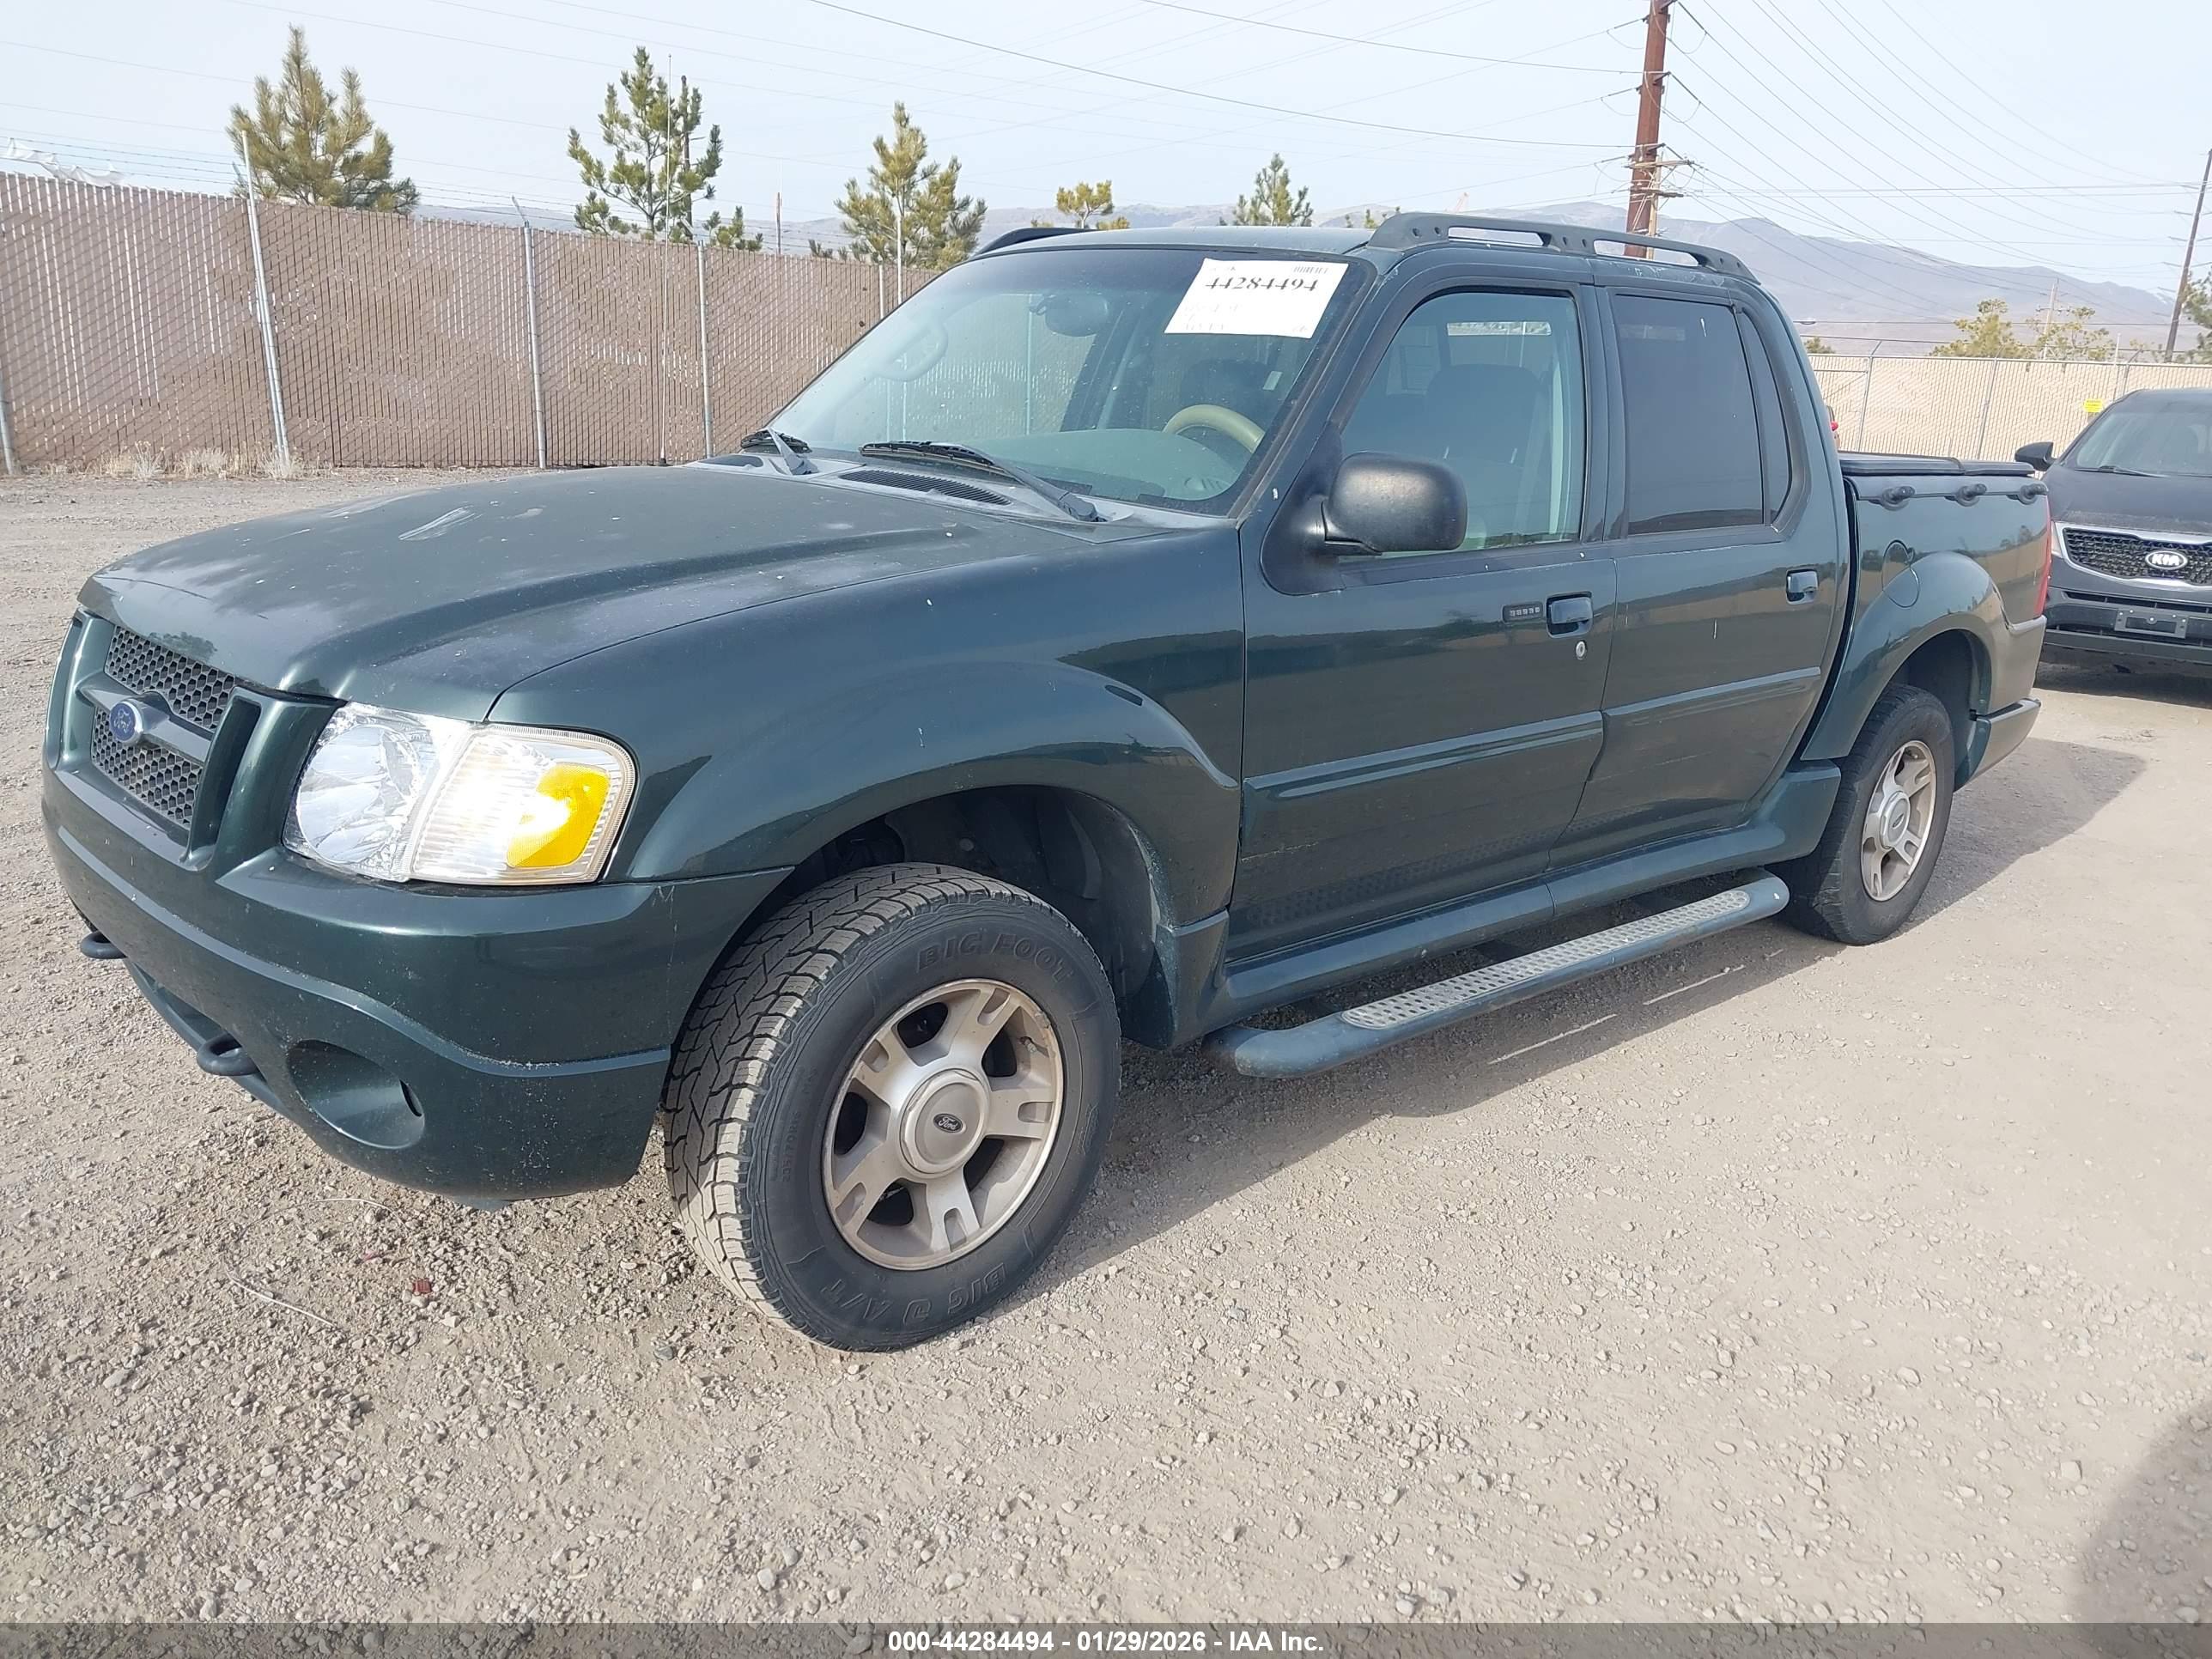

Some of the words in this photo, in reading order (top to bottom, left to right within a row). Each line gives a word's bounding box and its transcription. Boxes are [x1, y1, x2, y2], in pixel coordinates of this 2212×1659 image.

[1205, 276, 1319, 293] 44284494
[916, 932, 983, 974] BIG
[937, 1115, 960, 1131] Ford
[946, 1262, 1007, 1315] BIG
